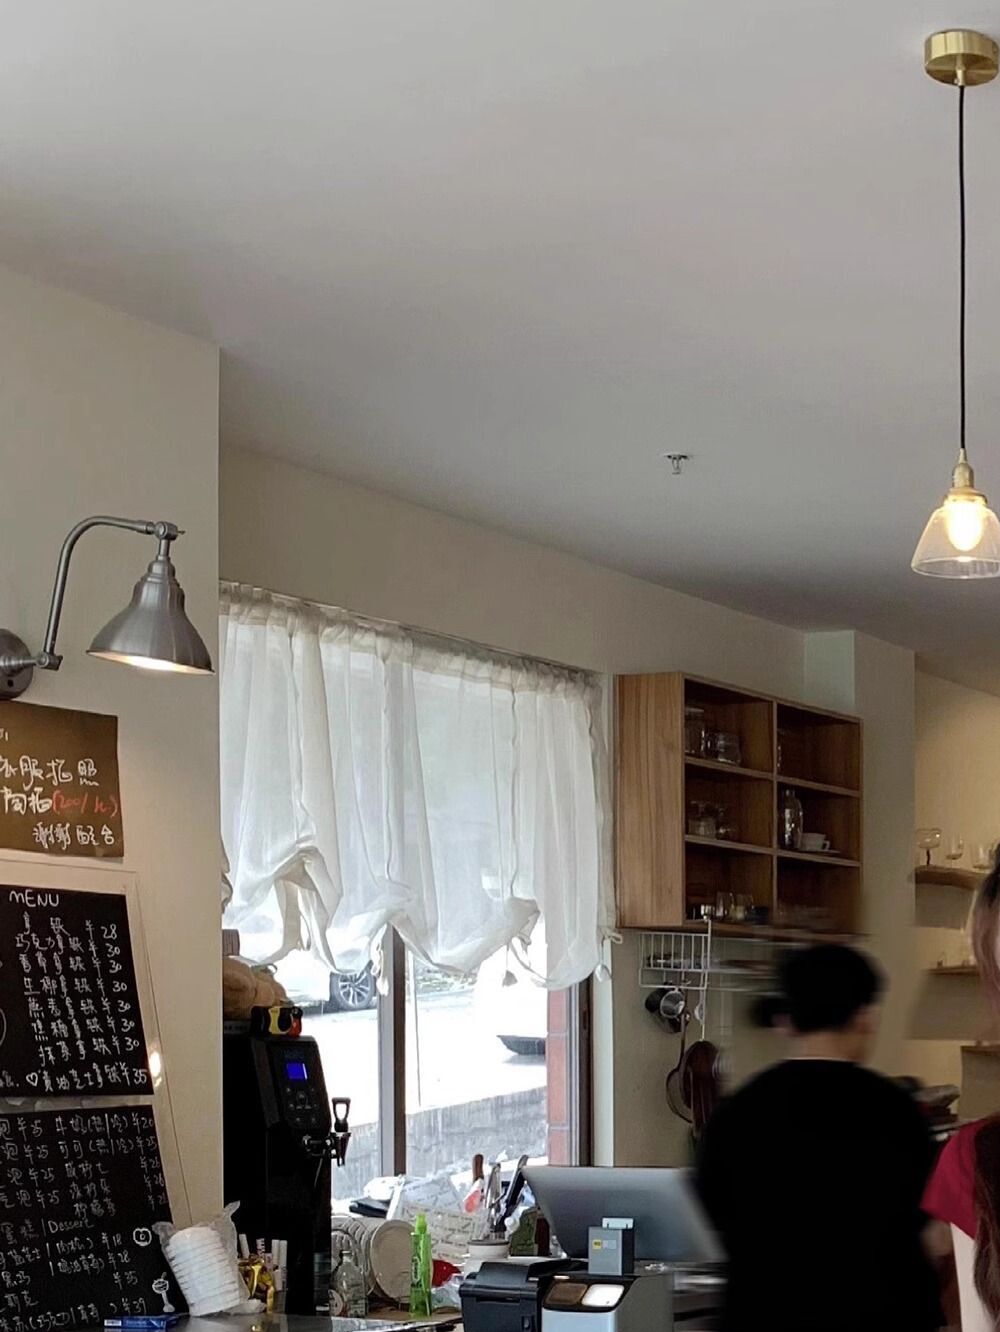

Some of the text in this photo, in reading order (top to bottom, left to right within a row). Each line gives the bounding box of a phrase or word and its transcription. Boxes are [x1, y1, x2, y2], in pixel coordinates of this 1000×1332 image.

[32, 822, 115, 850] 谢谢配合
[9, 889, 60, 907] MENU
[48, 1218, 95, 1233] Dessert
